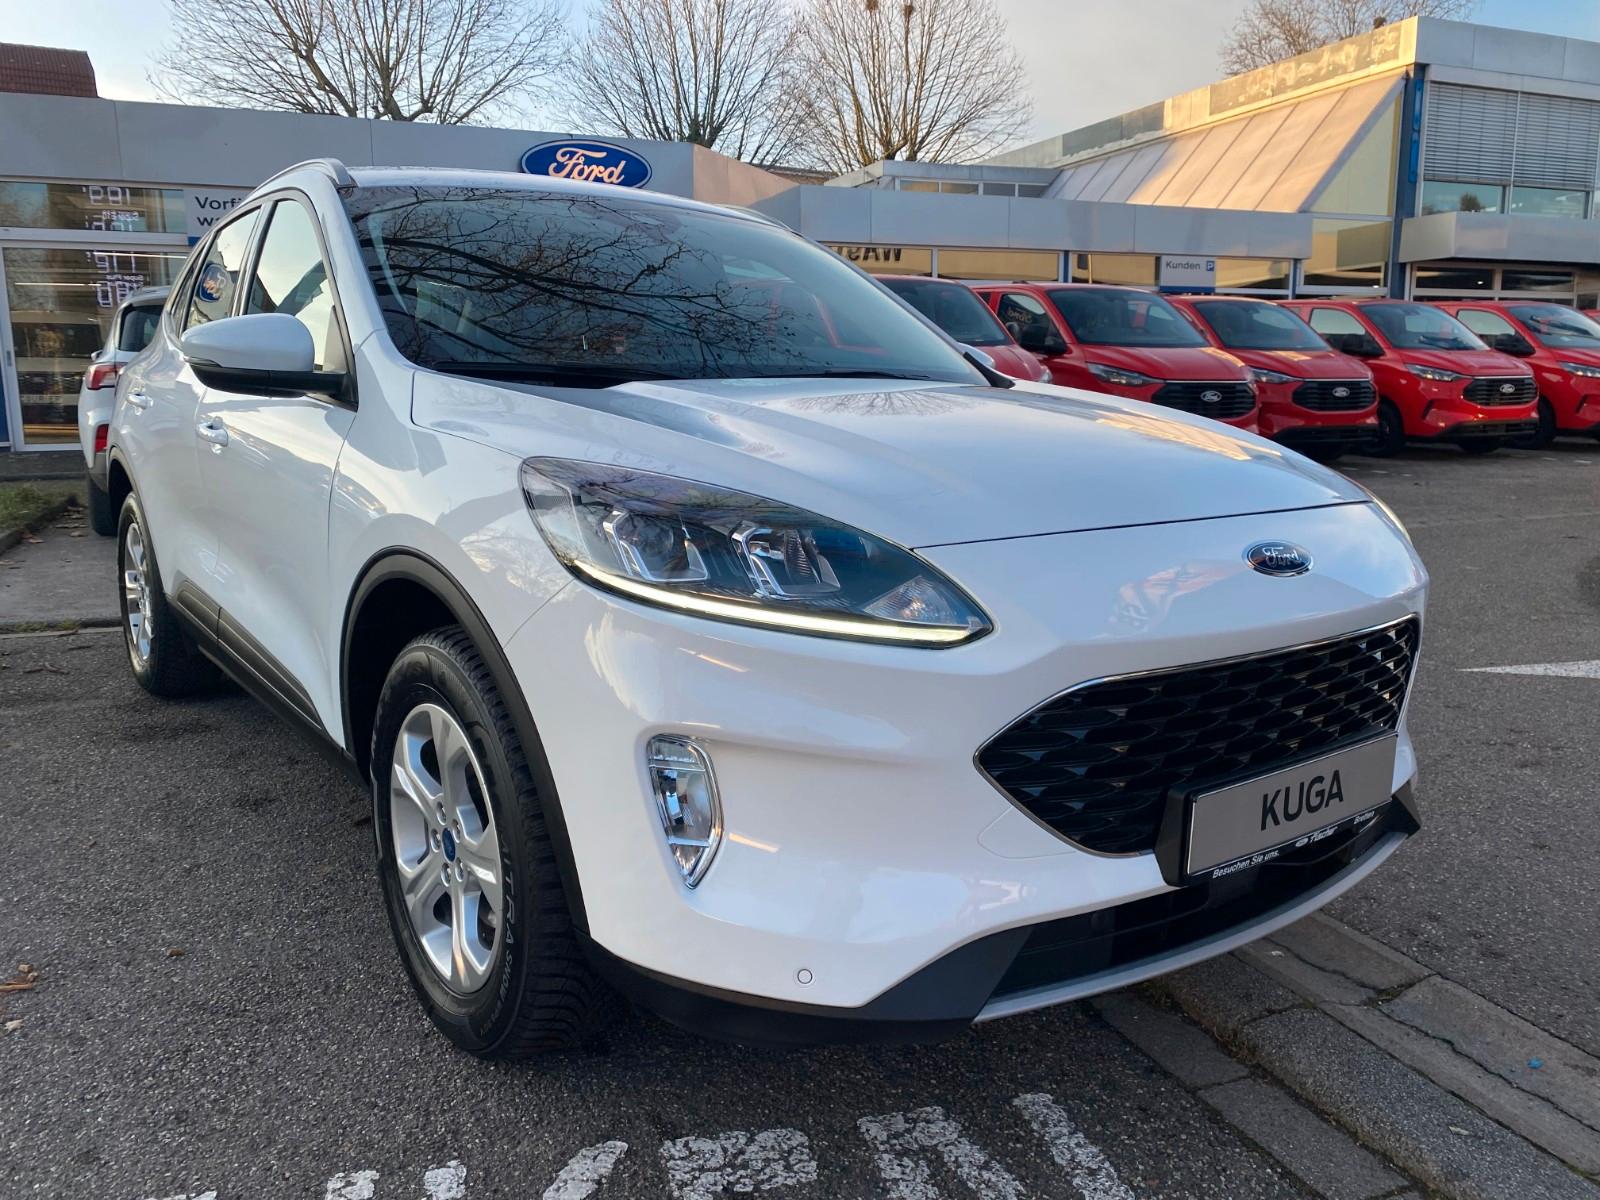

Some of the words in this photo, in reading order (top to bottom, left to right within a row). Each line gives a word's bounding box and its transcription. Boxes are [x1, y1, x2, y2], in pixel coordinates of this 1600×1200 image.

[548, 147, 626, 184] Ford
[1166, 261, 1201, 270] Kunden
[1261, 769, 1344, 831] KUGA
[1212, 860, 1251, 879] Besuchen
[1251, 854, 1264, 865] Sie
